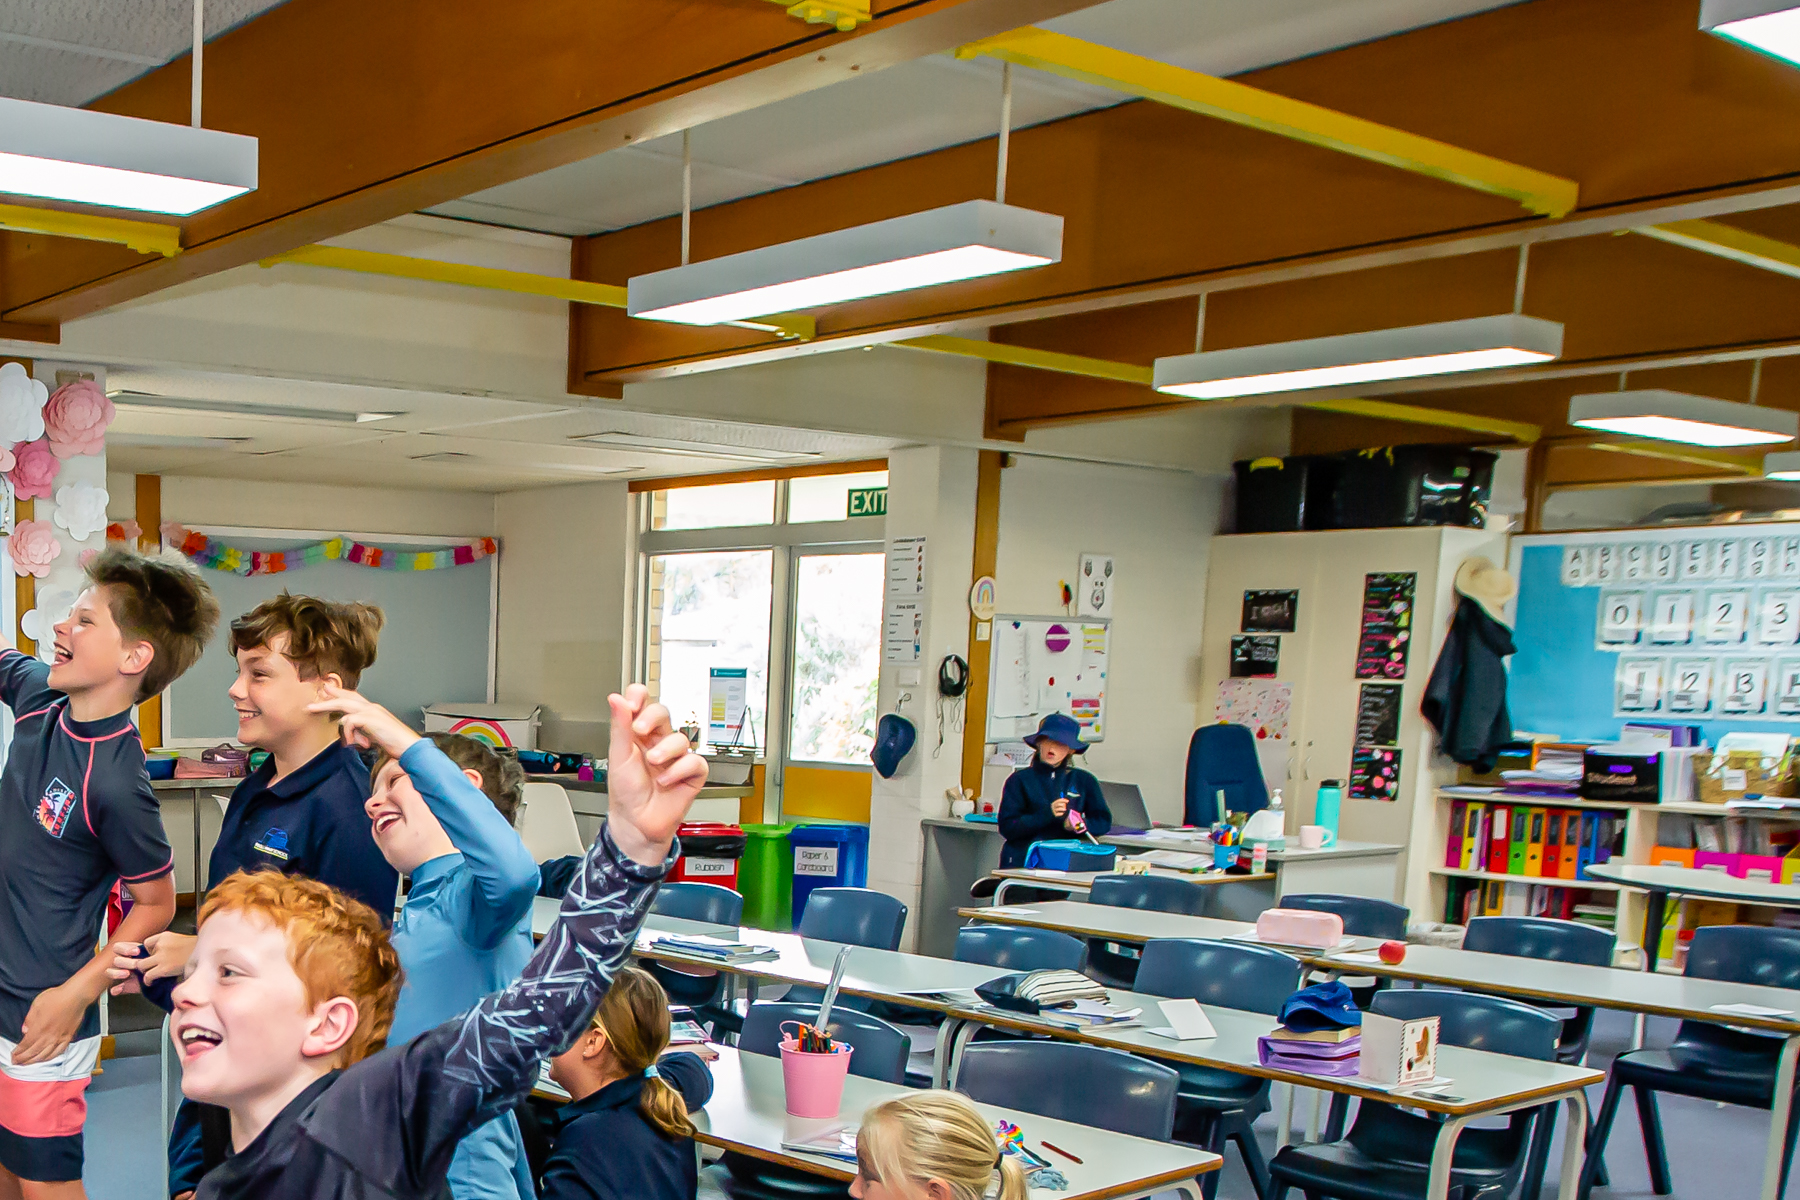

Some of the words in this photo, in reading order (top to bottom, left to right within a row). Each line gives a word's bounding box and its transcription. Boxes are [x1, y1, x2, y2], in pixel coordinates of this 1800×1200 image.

[851, 490, 888, 513] EXIT
[1570, 550, 1583, 564] A
[1600, 547, 1611, 563] B
[1627, 546, 1640, 562] C
[1659, 545, 1671, 562] D
[1689, 543, 1702, 560] E
[1720, 541, 1736, 559] F
[1751, 540, 1767, 557] G
[1611, 604, 1629, 625] 0
[1667, 604, 1675, 625] 1
[1717, 603, 1732, 625] 2
[1771, 603, 1789, 625] 3
[1681, 671, 1699, 692] 12
[802, 851, 821, 861] Paper
[797, 863, 834, 872] Cardboard
